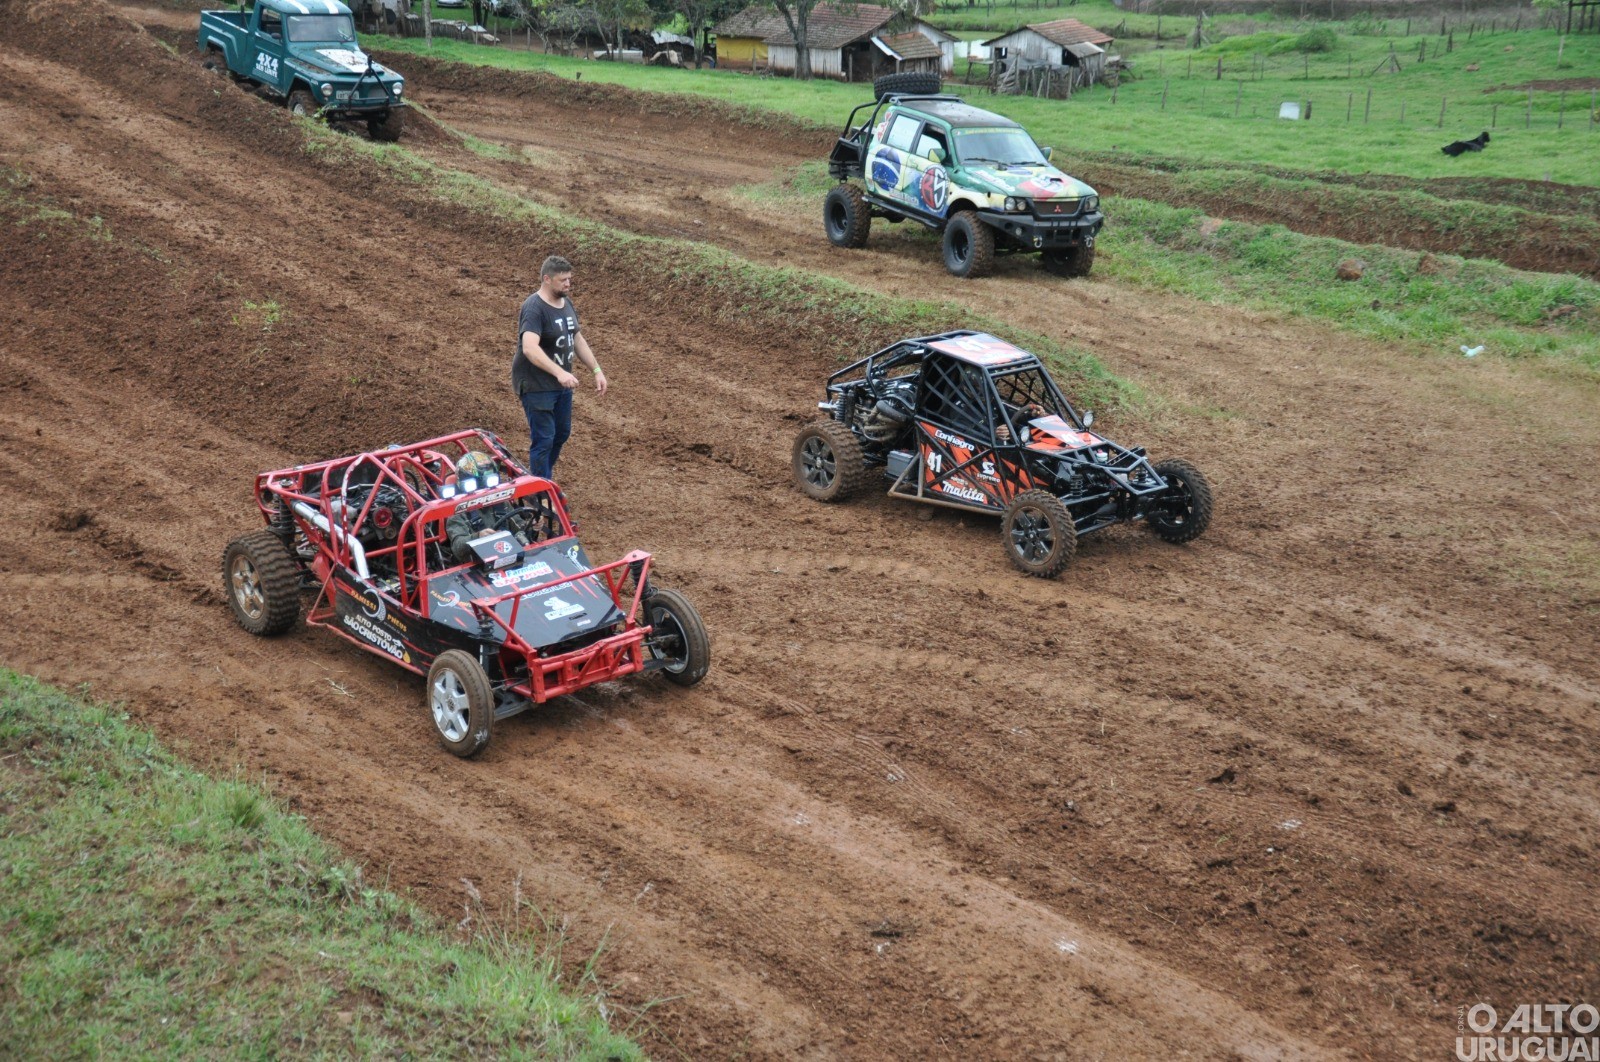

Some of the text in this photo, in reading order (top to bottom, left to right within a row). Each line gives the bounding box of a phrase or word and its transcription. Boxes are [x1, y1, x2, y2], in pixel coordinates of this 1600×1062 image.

[927, 452, 942, 473] 41
[344, 615, 359, 630] SÃO
[359, 626, 403, 659] CRISTÓVÃO
[372, 624, 392, 640] POSTO
